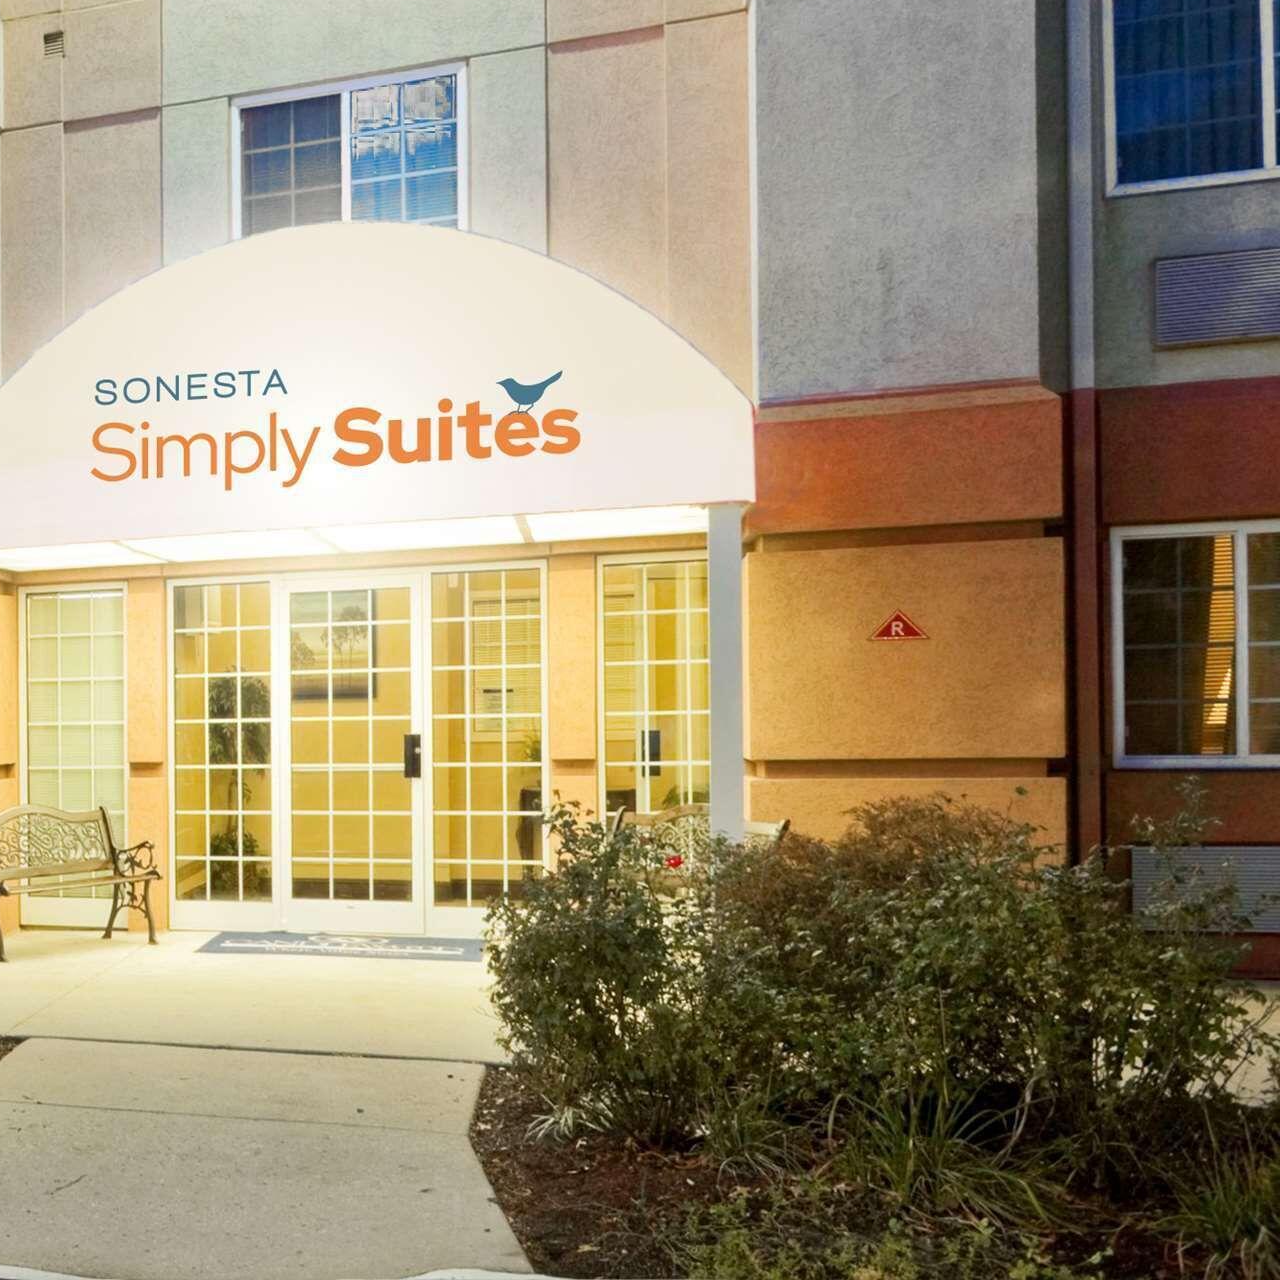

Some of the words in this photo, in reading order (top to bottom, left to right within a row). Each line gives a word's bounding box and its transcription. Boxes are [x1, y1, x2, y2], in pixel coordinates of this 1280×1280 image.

[94, 369, 288, 405] SONESTA
[90, 412, 321, 491] Simply
[332, 398, 582, 467] Suites
[891, 621, 905, 636] R
